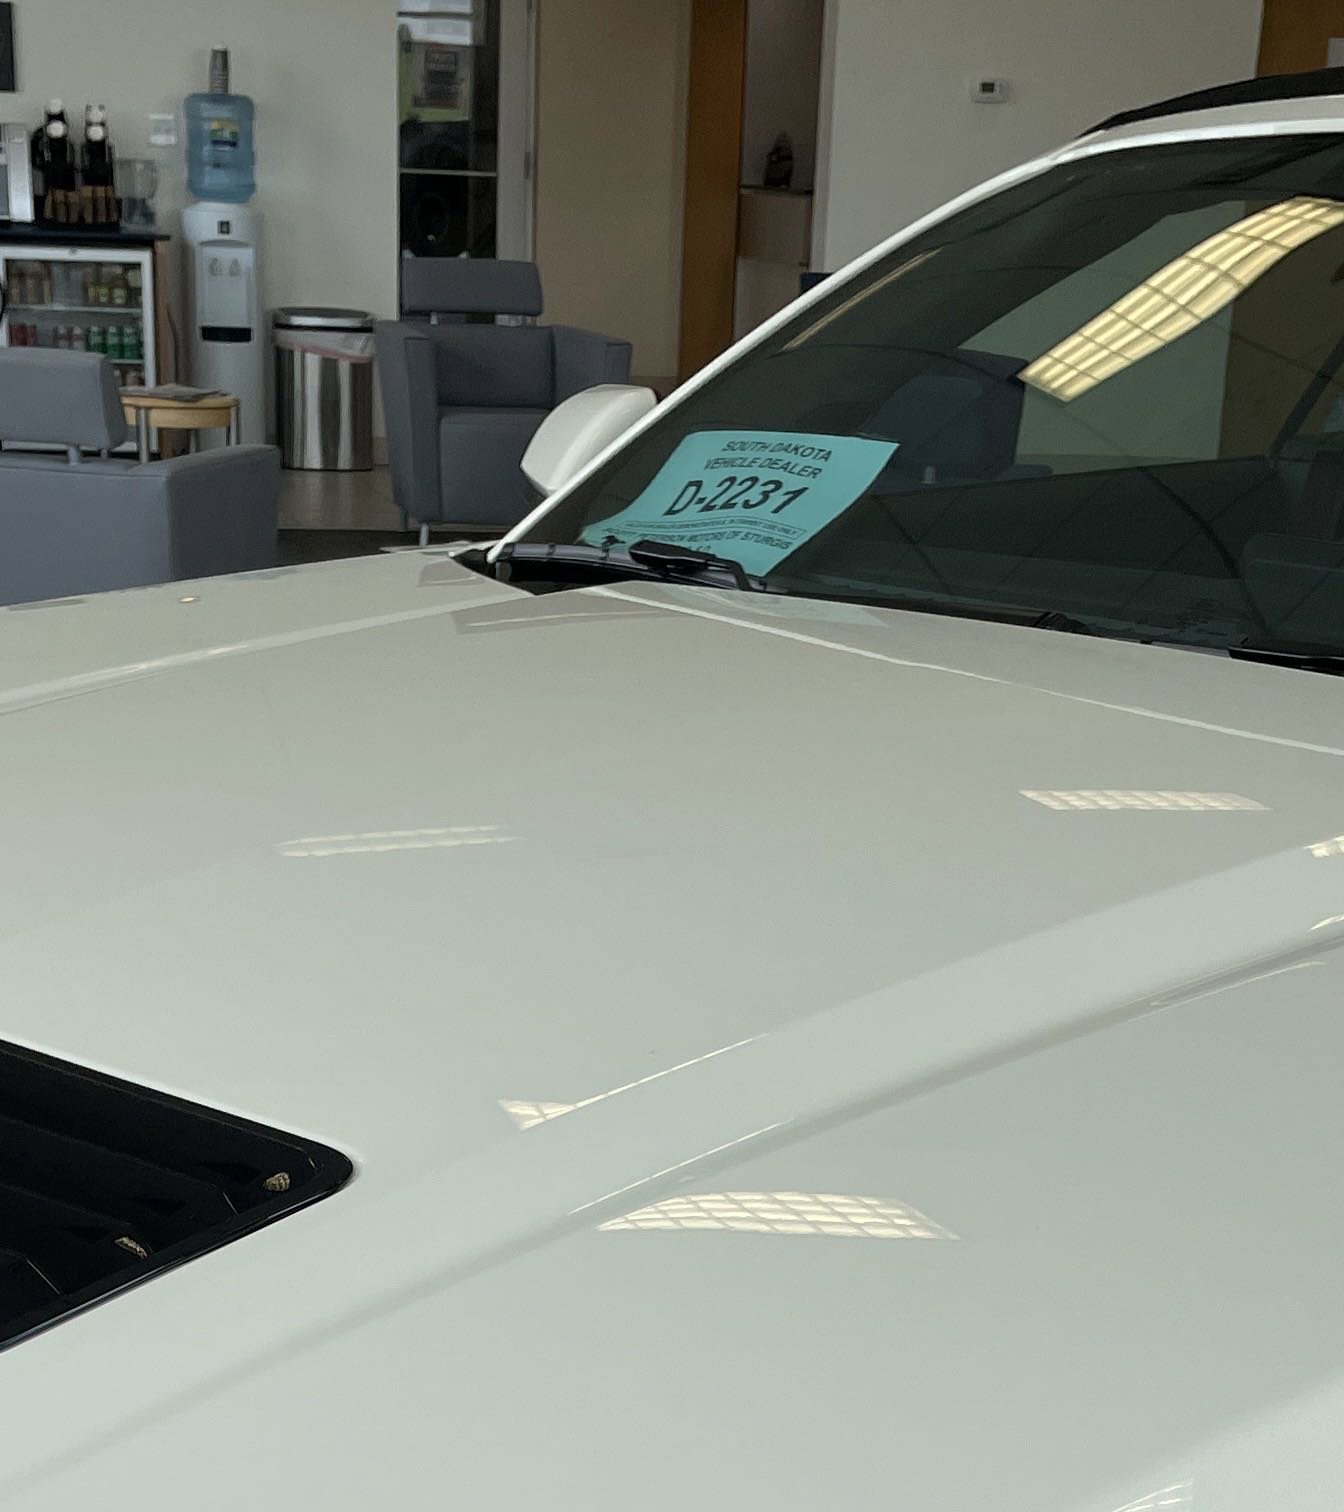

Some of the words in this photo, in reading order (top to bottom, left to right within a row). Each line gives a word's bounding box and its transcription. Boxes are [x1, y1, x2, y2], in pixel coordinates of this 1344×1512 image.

[720, 440, 768, 453] SOUTH
[769, 441, 833, 462] DAKOTA
[703, 459, 759, 471] VEHICLE
[759, 458, 823, 480] DEALER
[662, 475, 810, 516] D-2231
[740, 531, 793, 550] STURGIS
